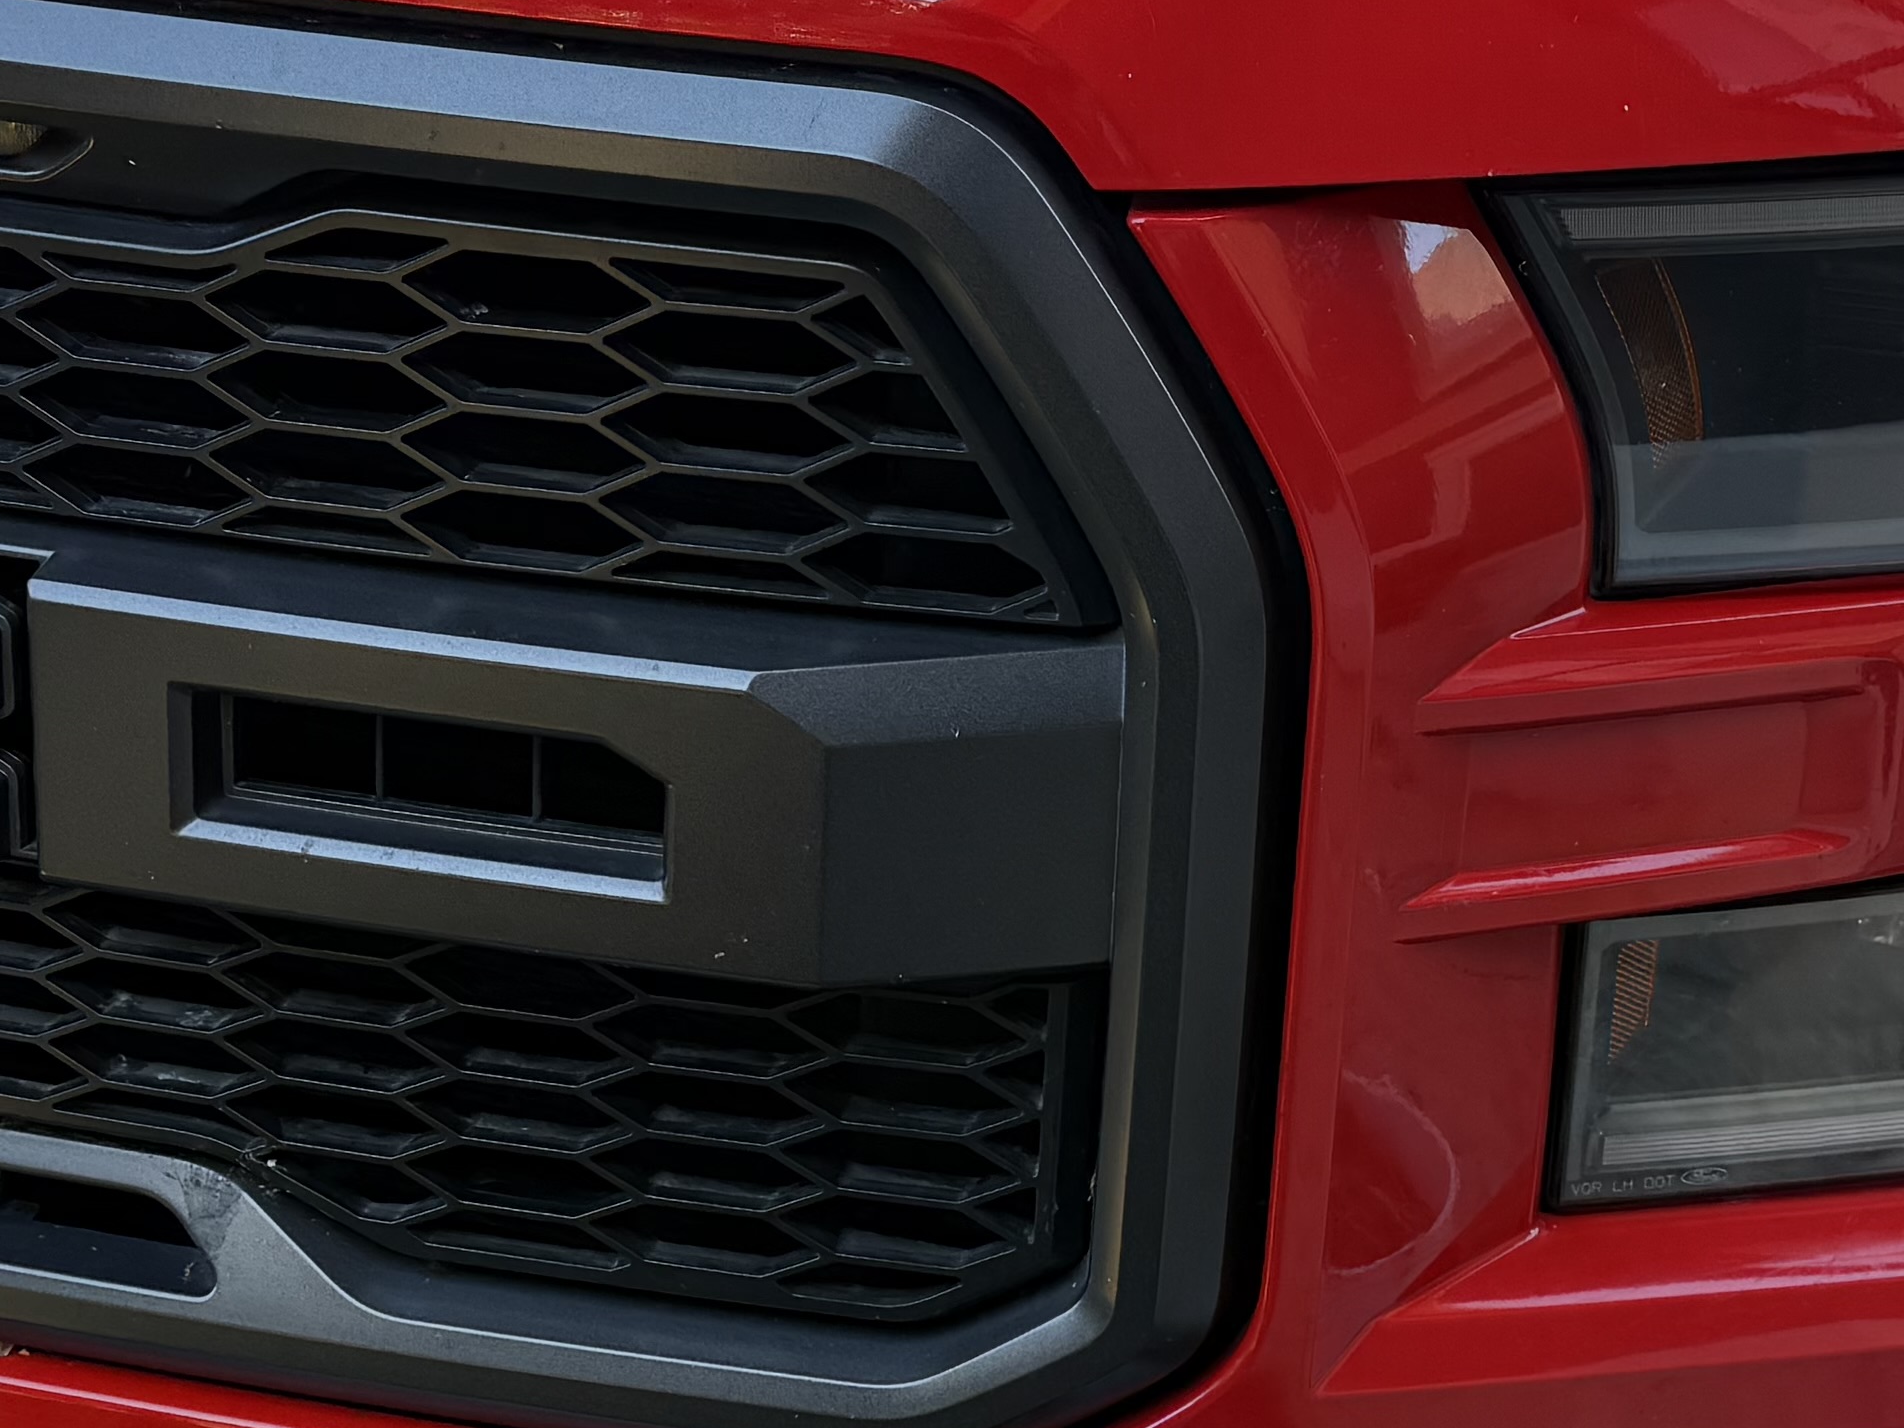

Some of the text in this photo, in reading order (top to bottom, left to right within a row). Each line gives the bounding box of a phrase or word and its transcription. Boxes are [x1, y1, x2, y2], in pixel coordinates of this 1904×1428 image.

[1571, 1181, 1603, 1196] VOR
[1612, 1180, 1634, 1193] LH
[1643, 1174, 1676, 1189] DOT
